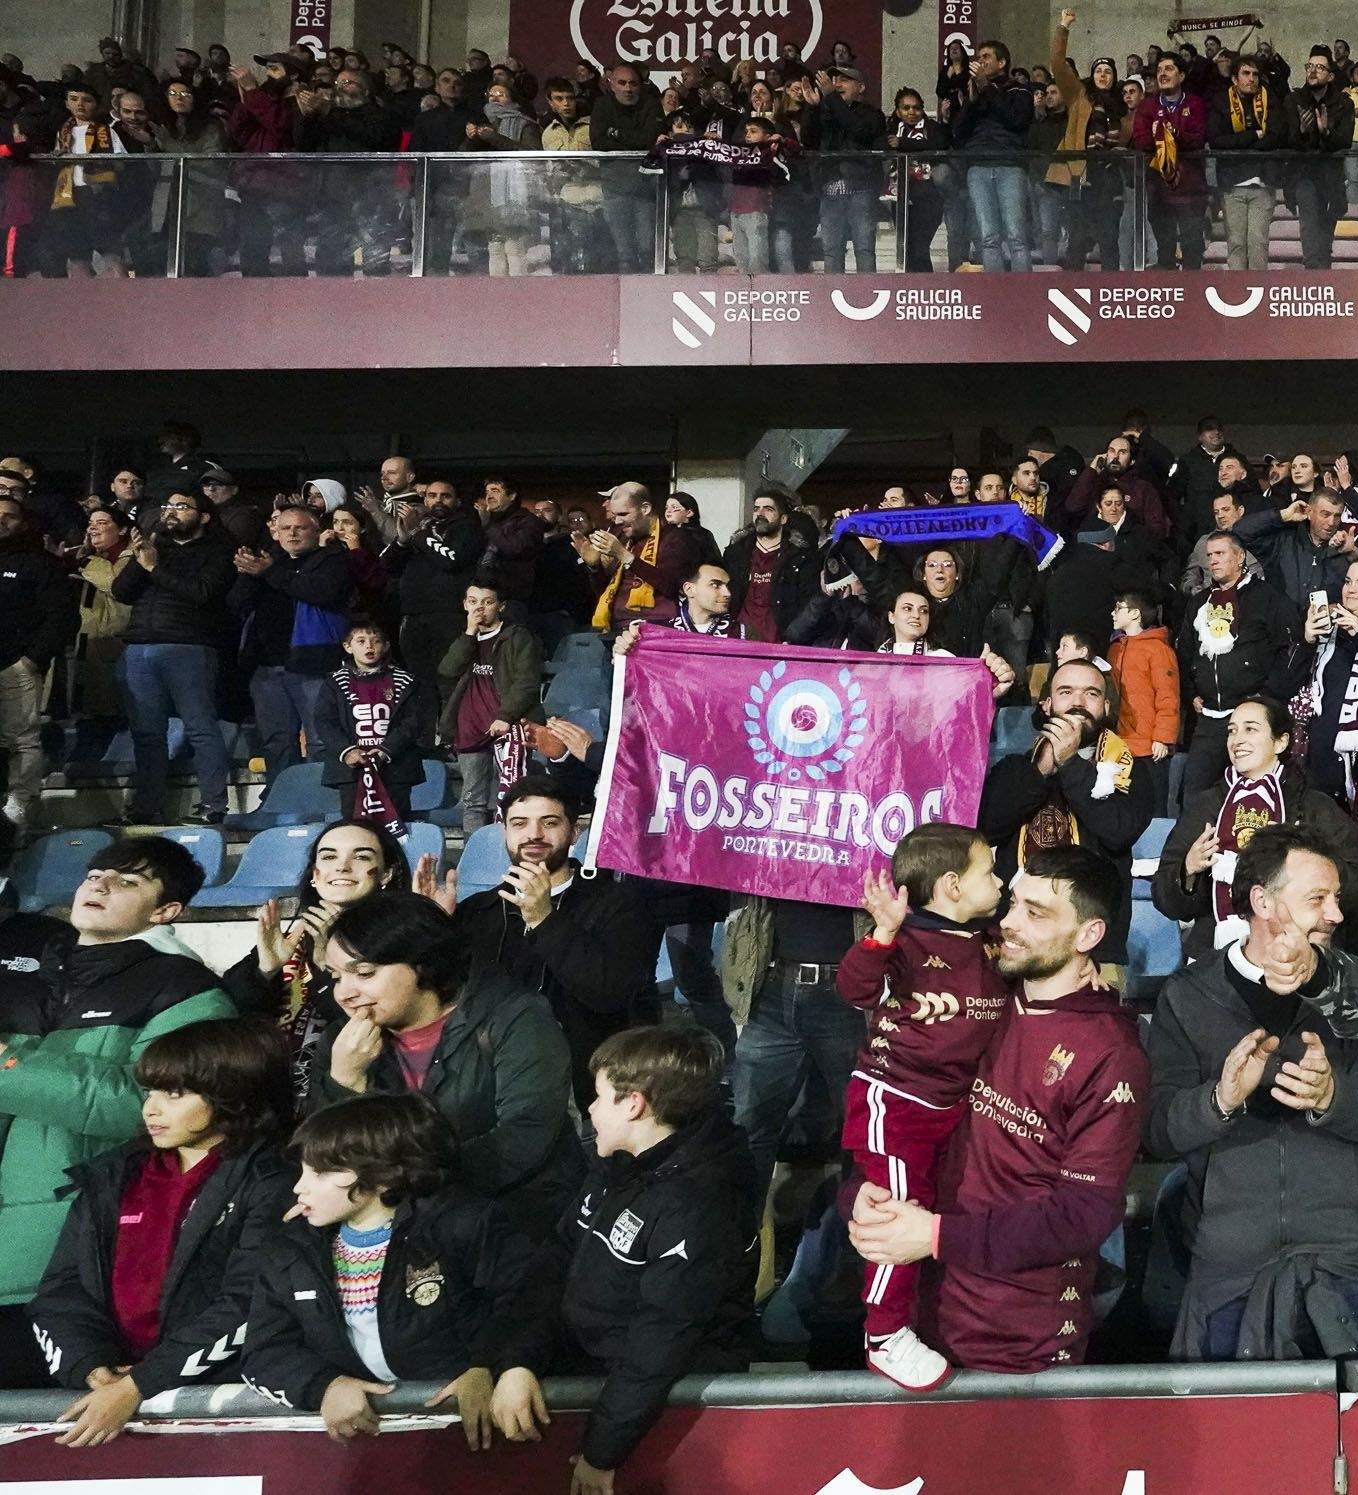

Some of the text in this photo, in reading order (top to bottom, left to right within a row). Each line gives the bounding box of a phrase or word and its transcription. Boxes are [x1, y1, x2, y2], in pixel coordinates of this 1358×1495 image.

[1182, 23, 1207, 31] NUNCA
[1221, 19, 1243, 27] RINDE
[615, 20, 780, 63] Galicia
[724, 290, 811, 305] DEPORTE
[895, 289, 962, 304] GALICIA
[1098, 287, 1185, 302] DEPORTE
[1268, 285, 1335, 301] GALICIA
[723, 307, 801, 322] GALEGO
[895, 305, 982, 320] SAUDABLE
[1098, 304, 1176, 319] GALEGO
[1268, 302, 1354, 317] SAUDABLE
[722, 836, 851, 867] PONTEVEDRA
[972, 1078, 1047, 1130] Deputación
[1070, 1171, 1096, 1182] VOLTAR
